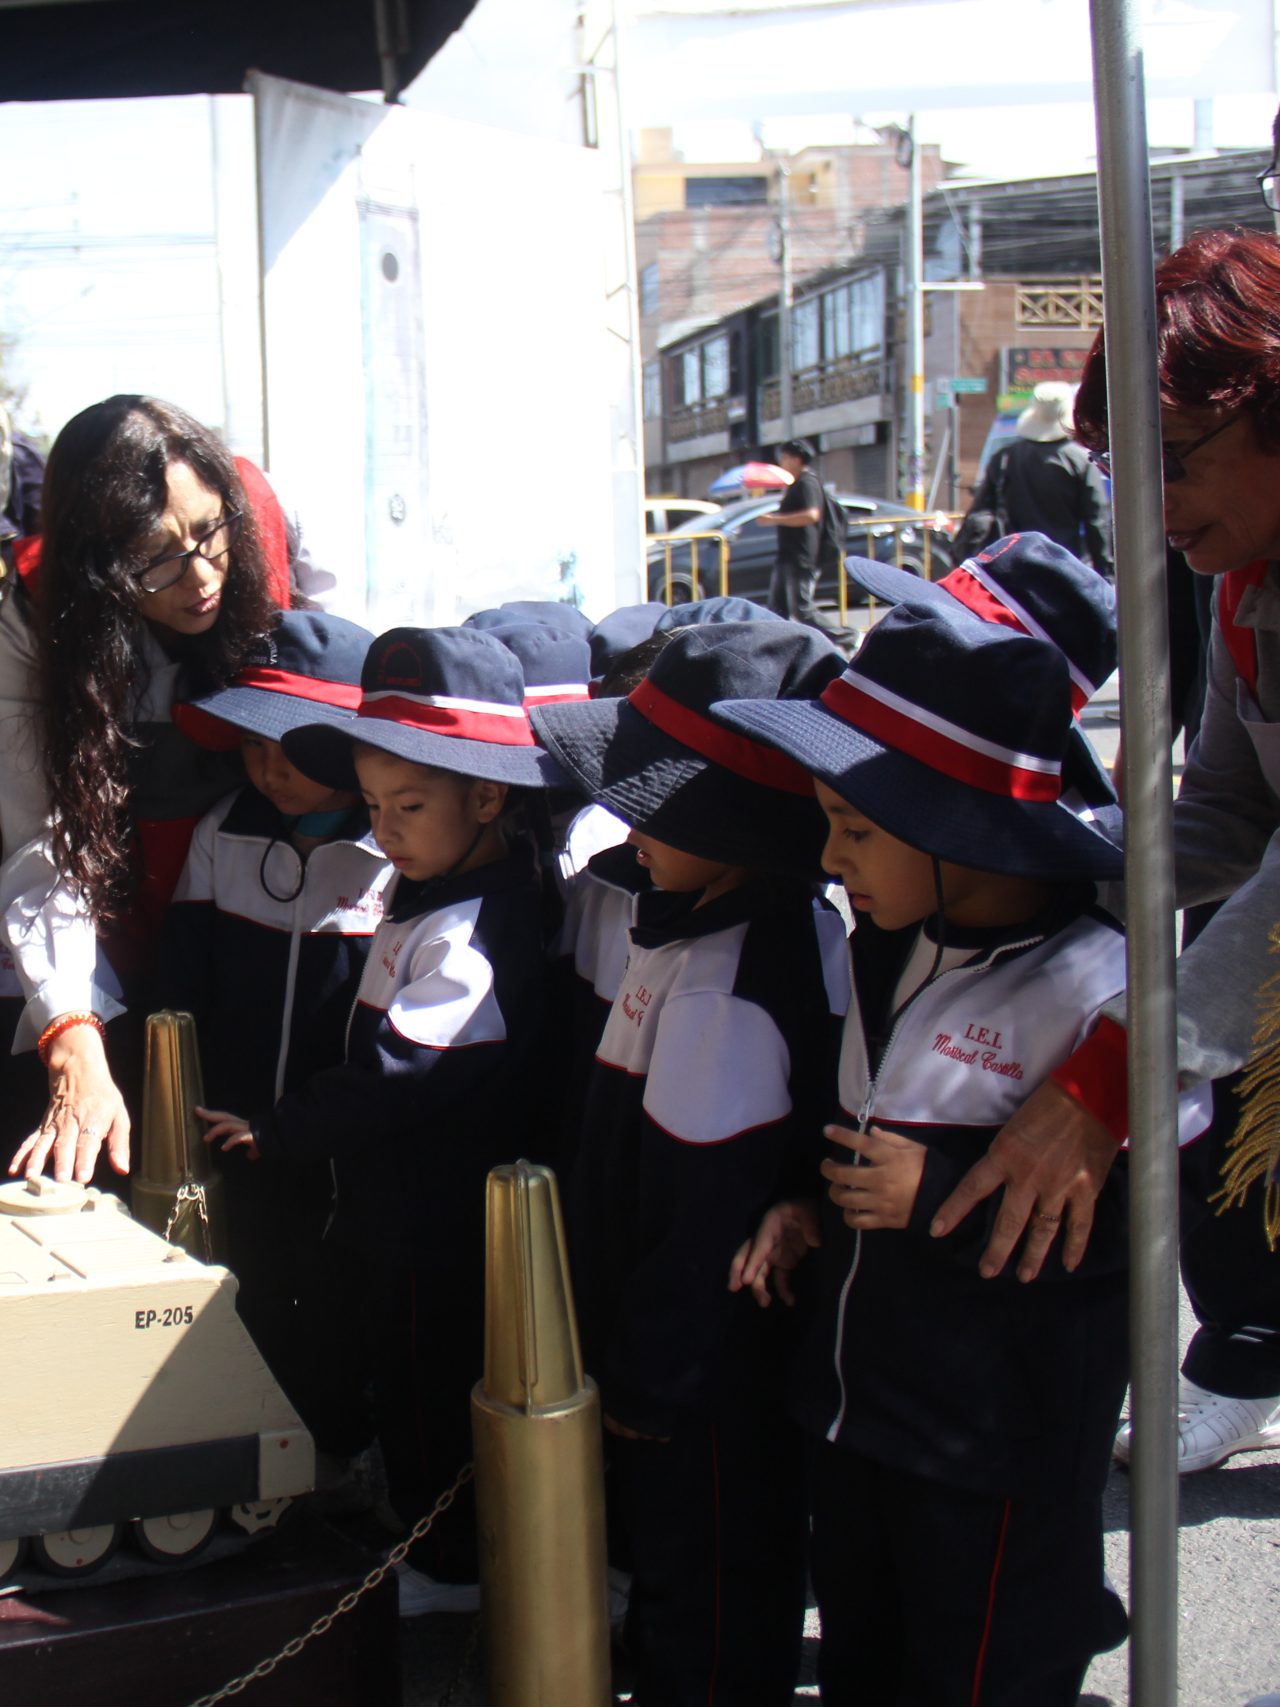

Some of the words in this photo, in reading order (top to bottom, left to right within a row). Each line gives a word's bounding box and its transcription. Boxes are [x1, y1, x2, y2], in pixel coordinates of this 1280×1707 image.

[931, 1033, 979, 1065] Mariscal
[964, 1024, 1002, 1050] I.E.I.
[134, 1305, 194, 1329] EP-205
